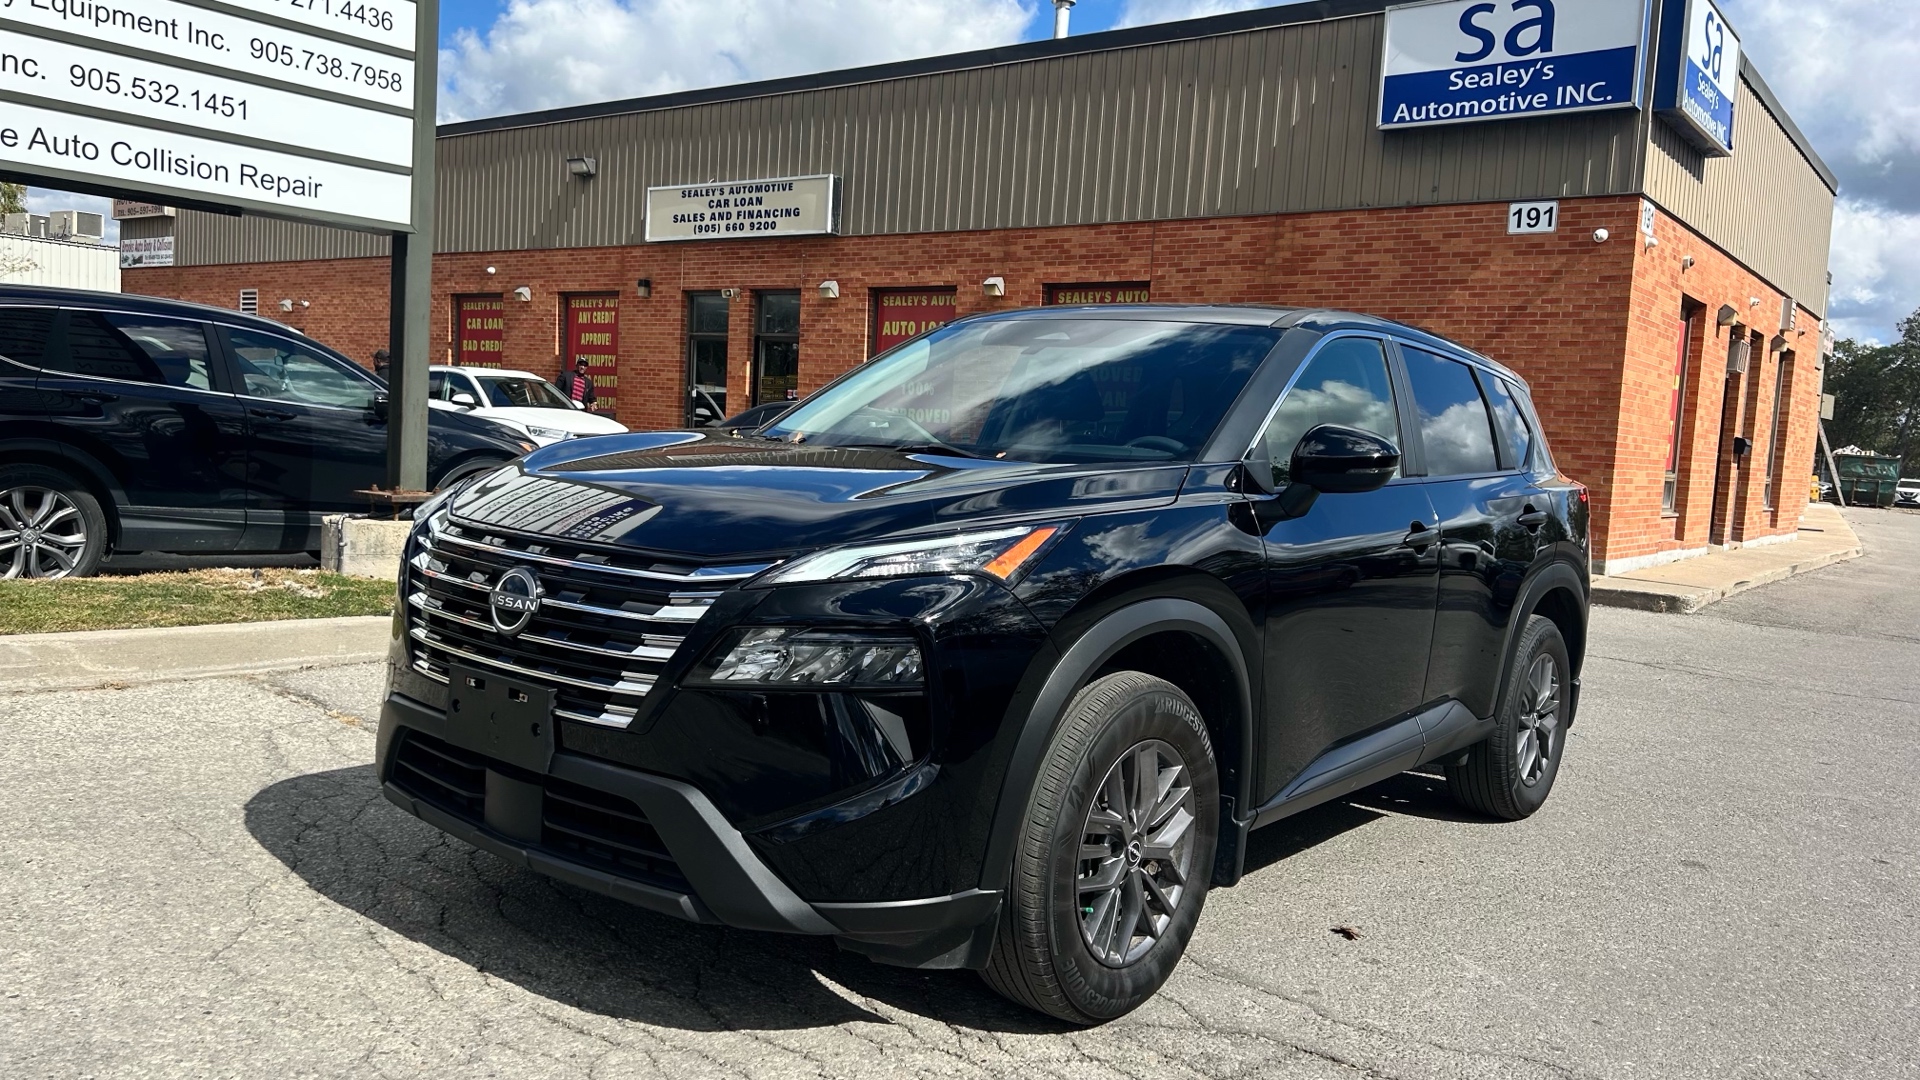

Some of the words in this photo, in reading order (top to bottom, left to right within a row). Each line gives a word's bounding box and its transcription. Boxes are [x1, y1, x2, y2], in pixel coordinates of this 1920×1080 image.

[1455, 0, 1556, 63] sa
[1702, 11, 1723, 83] sa
[188, 22, 231, 52] Inc.
[250, 38, 402, 92] 905.738.7958
[1449, 61, 1555, 91] Sealey's
[69, 64, 248, 120] 905.532.1451
[1393, 91, 1549, 122] Automotive
[1556, 82, 1613, 105] INC.
[1683, 89, 1716, 134] Automotive
[28, 127, 99, 160] Auto
[111, 141, 229, 183] Collision
[240, 164, 323, 198] Repair
[681, 187, 725, 198] SEALEY'S
[728, 182, 794, 196] AUTOMOTIVE
[708, 199, 730, 209] CAR
[734, 196, 763, 207] LOAN
[672, 213, 706, 224] SALES
[709, 210, 732, 221] AND
[736, 207, 801, 219] FINANCING
[1511, 206, 1555, 230] 191
[693, 223, 721, 234] (905)
[725, 222, 745, 232] 660
[749, 220, 777, 231] 9200
[571, 299, 603, 309] SEALEY'S
[883, 295, 928, 307] SEALEY'S
[930, 294, 957, 306] AUTO
[1058, 291, 1112, 304] SEALEY'S
[1116, 290, 1149, 303] AUTO
[462, 302, 491, 311] SEALEY'S
[466, 318, 482, 330] CAR
[578, 311, 592, 324] ANY
[592, 311, 616, 324] CREDIT
[882, 320, 916, 336] AUTO
[462, 340, 478, 352] BAD
[1154, 694, 1214, 765] BRIDGESTONE
